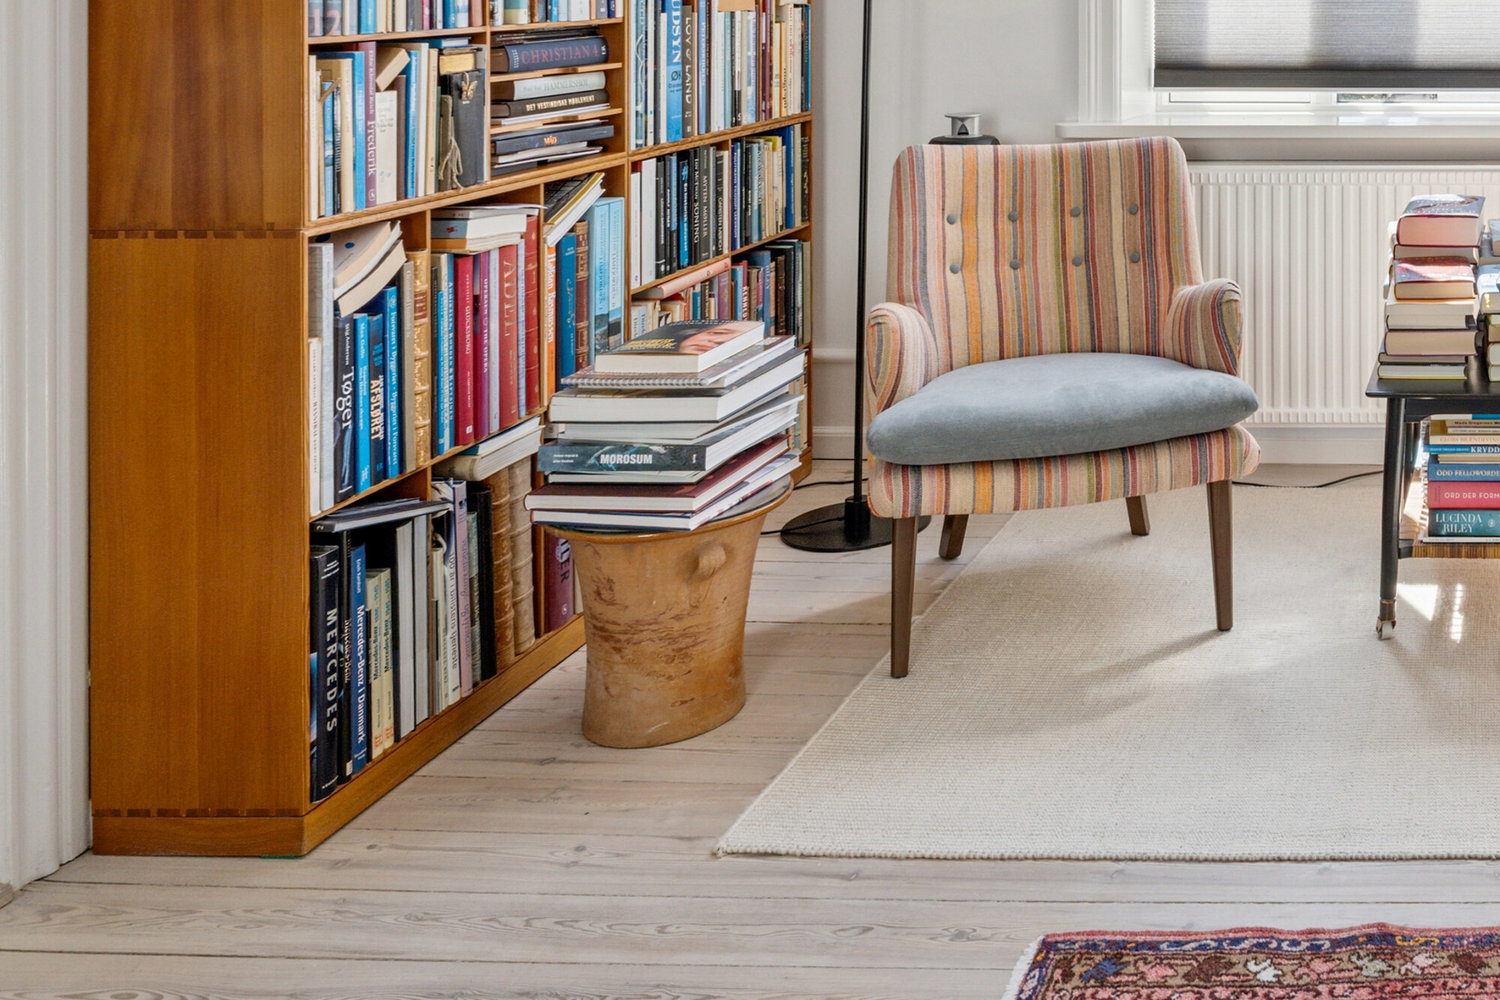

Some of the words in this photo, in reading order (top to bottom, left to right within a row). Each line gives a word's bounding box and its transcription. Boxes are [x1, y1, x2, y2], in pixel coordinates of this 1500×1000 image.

[521, 45, 590, 64] CHRISTIAN
[593, 44, 600, 57] 4
[526, 104, 536, 112] DET
[368, 120, 376, 176] Frederik
[548, 254, 556, 289] Halfdan
[504, 260, 516, 336] ADEL
[548, 292, 556, 342] Rasmussen
[336, 367, 354, 429] Tøger
[370, 380, 380, 440] AFSLØRET
[600, 454, 653, 464] MOROSUM
[1435, 513, 1482, 523] LUCINDA
[1443, 523, 1473, 533] RILEY
[450, 572, 455, 580] år
[450, 631, 458, 670] tjeneste
[326, 609, 337, 732] MERCEDES
